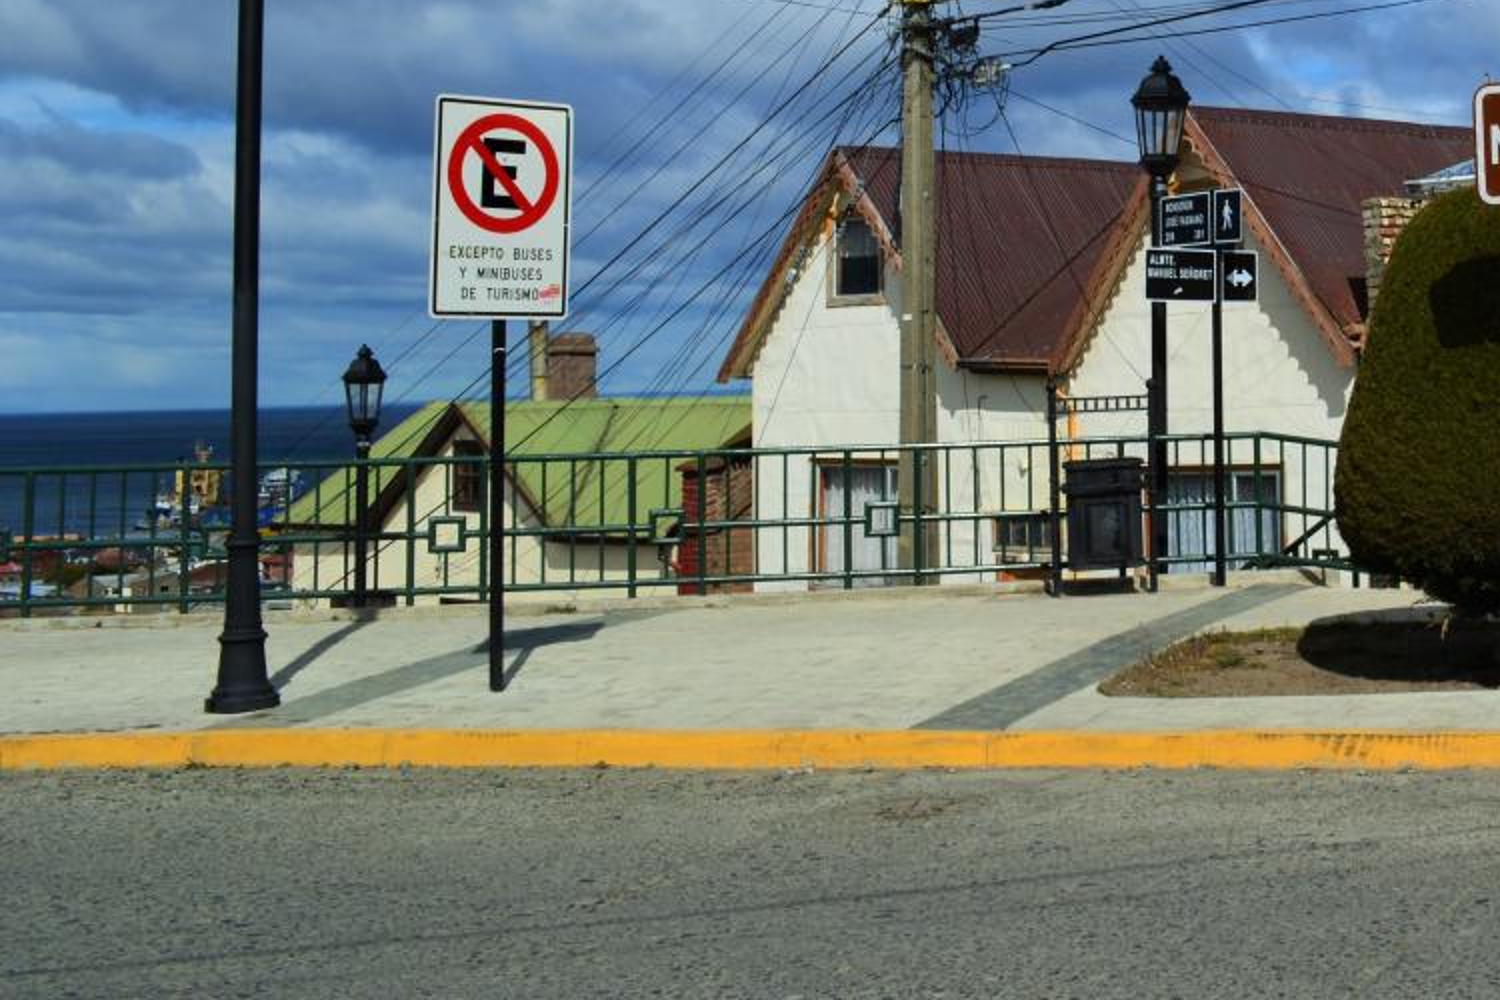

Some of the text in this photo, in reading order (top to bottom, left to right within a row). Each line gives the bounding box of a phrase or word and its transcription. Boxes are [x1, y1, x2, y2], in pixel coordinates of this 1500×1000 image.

[481, 137, 527, 209] E
[449, 245, 553, 261] EXCEPTO BUSES
[459, 267, 543, 281] Y MINIBUSES
[461, 287, 539, 301] DE TURISMO
